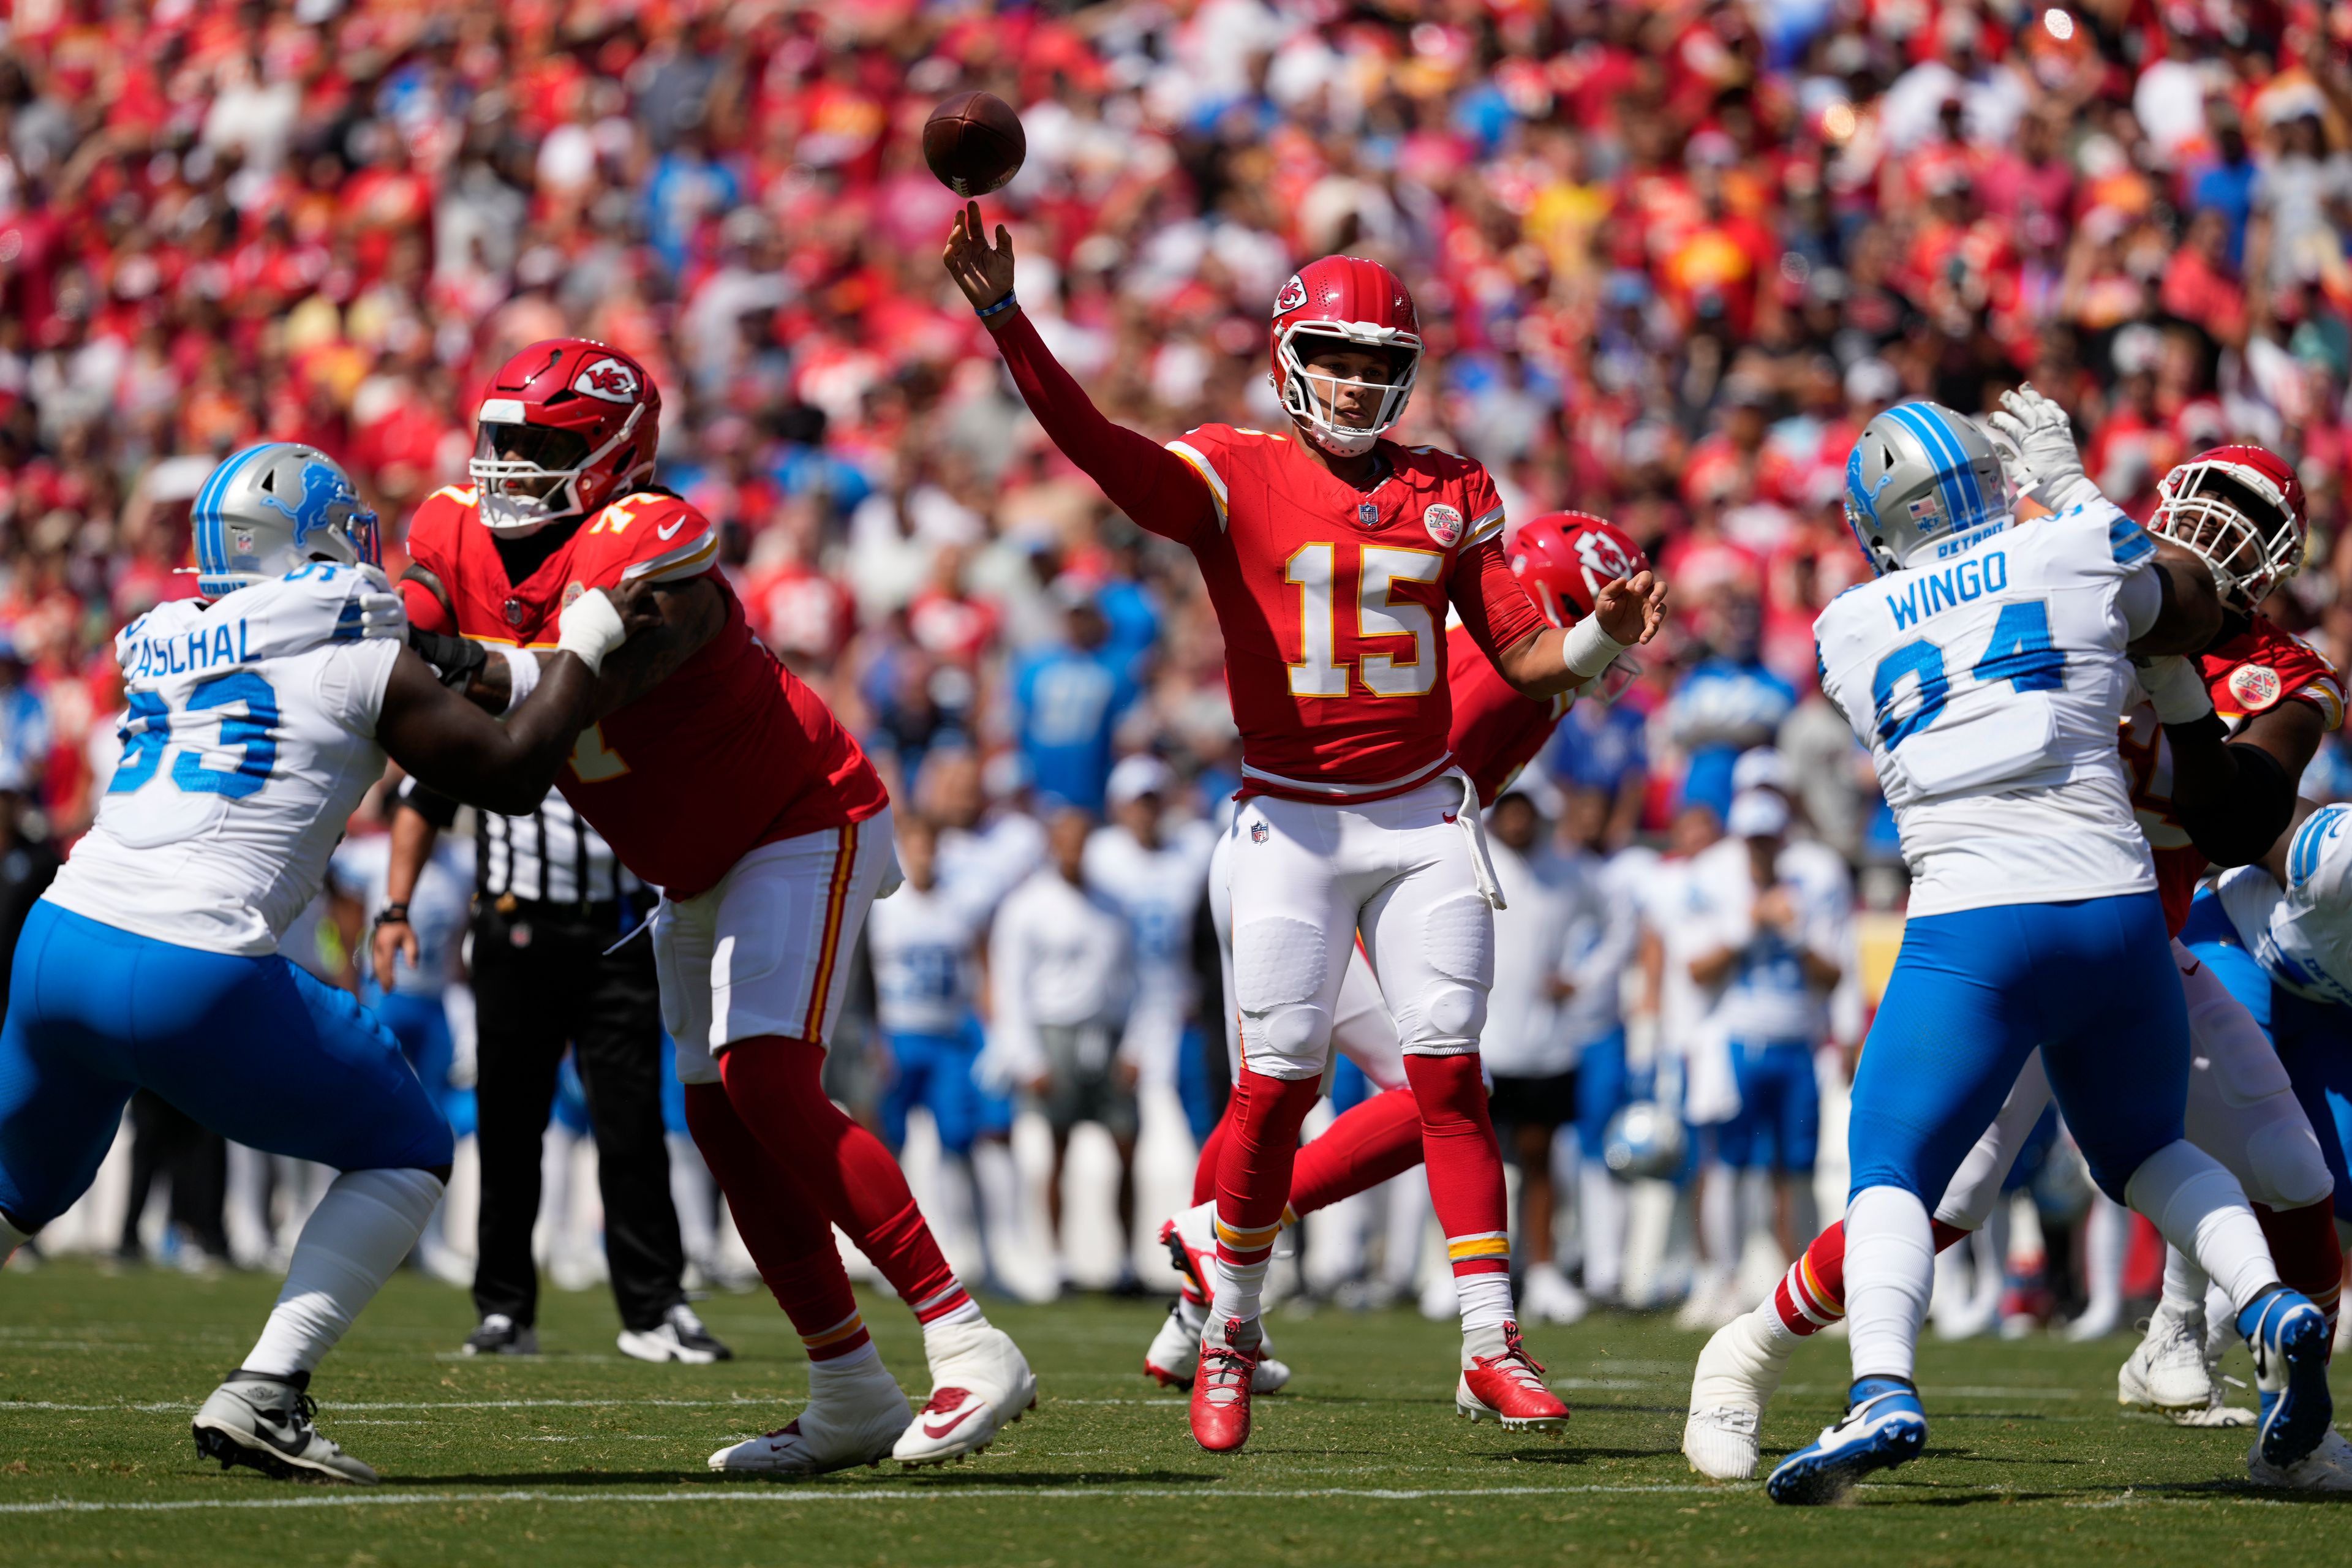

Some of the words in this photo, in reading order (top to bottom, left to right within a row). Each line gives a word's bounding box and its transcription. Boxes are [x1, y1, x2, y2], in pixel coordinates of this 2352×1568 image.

[1278, 282, 1302, 309] KC
[586, 368, 628, 395] KC
[1285, 541, 1446, 698] 15
[1886, 551, 2007, 631] WINGO
[130, 618, 262, 680] ASCHAL
